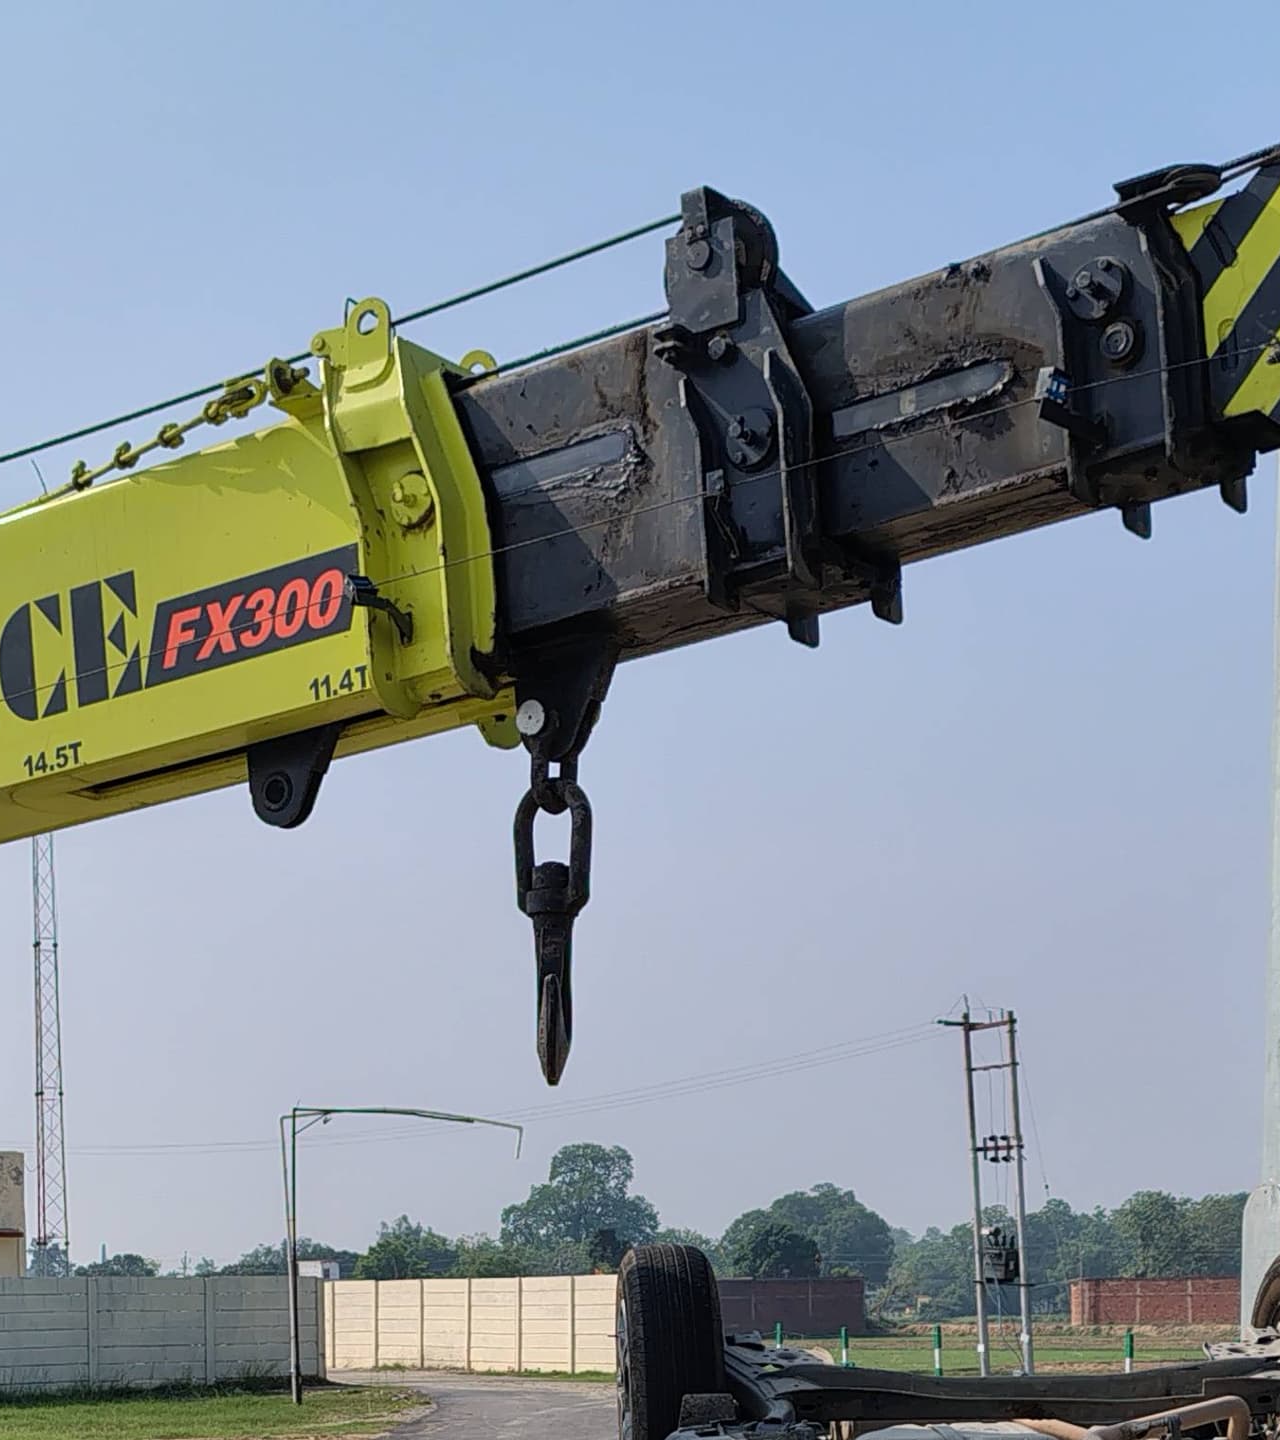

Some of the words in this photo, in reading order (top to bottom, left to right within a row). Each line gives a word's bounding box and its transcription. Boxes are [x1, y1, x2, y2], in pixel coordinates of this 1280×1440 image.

[162, 568, 344, 670] FX300
[309, 664, 367, 701] 11.4T
[22, 740, 83, 777] 14.5T
